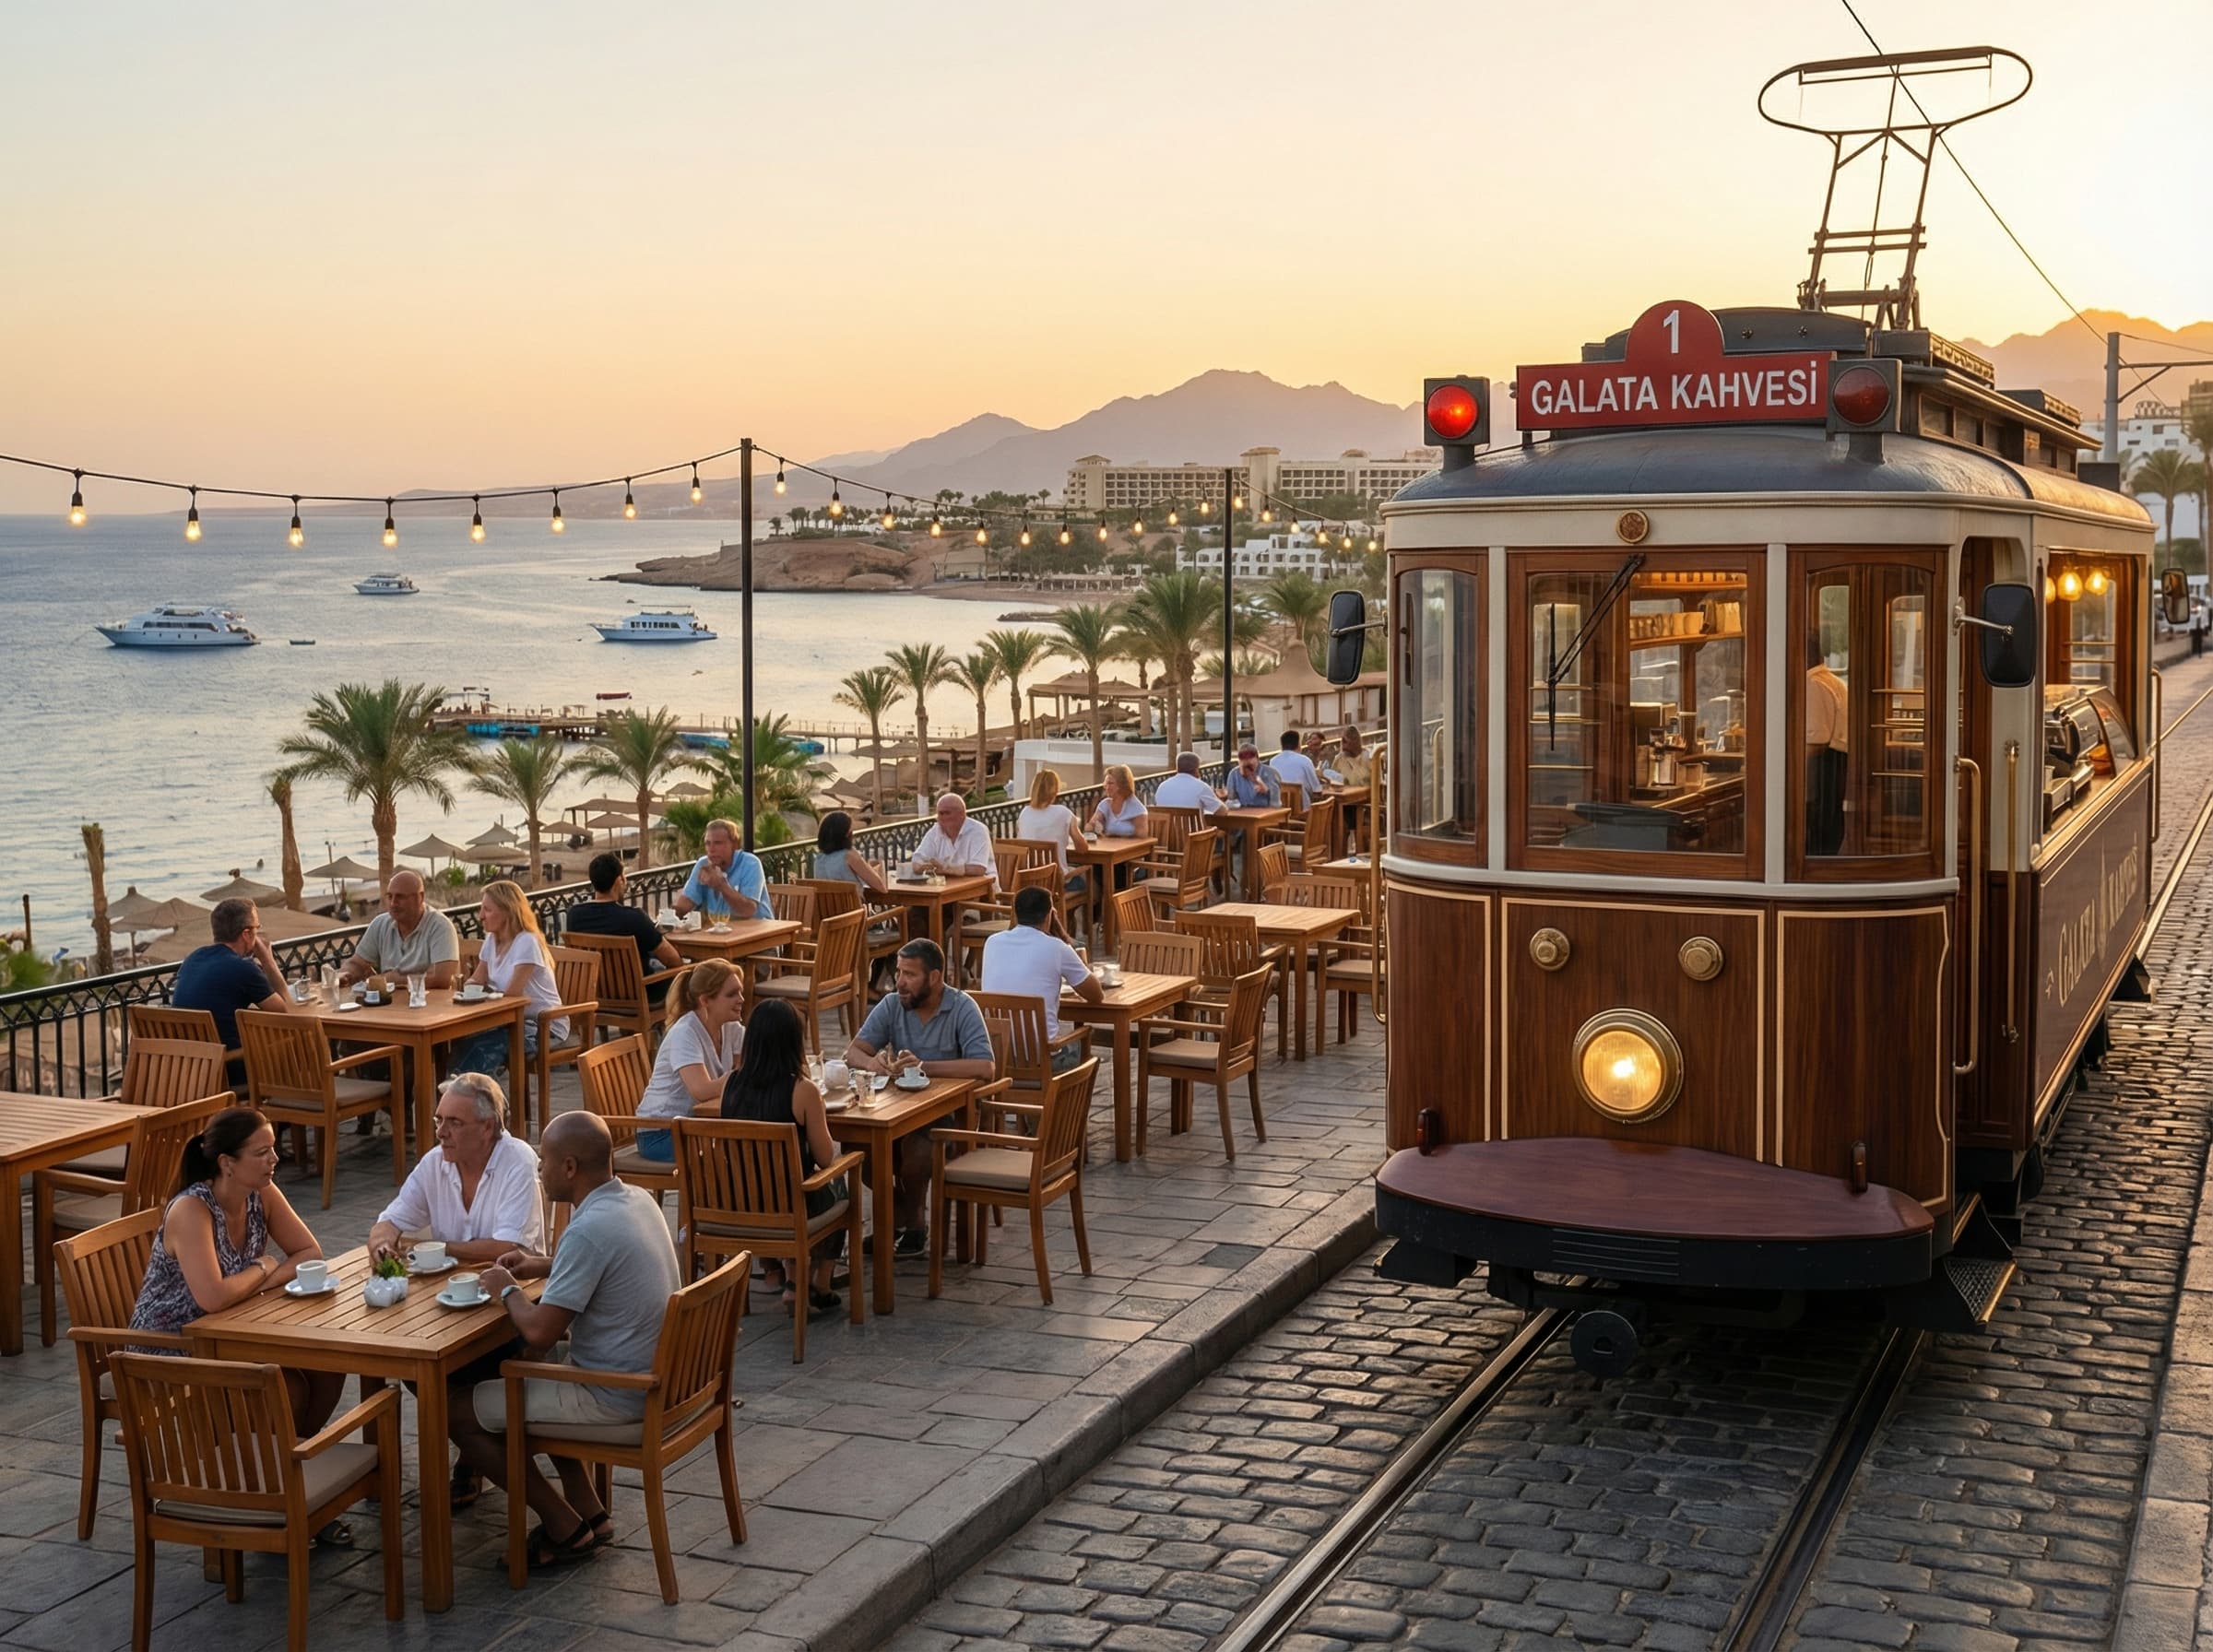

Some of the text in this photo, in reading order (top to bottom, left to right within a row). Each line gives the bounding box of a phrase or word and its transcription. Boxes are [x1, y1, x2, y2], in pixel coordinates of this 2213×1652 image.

[1663, 309, 1679, 354] 1
[1531, 360, 1817, 416] GALATA KAHVESİ
